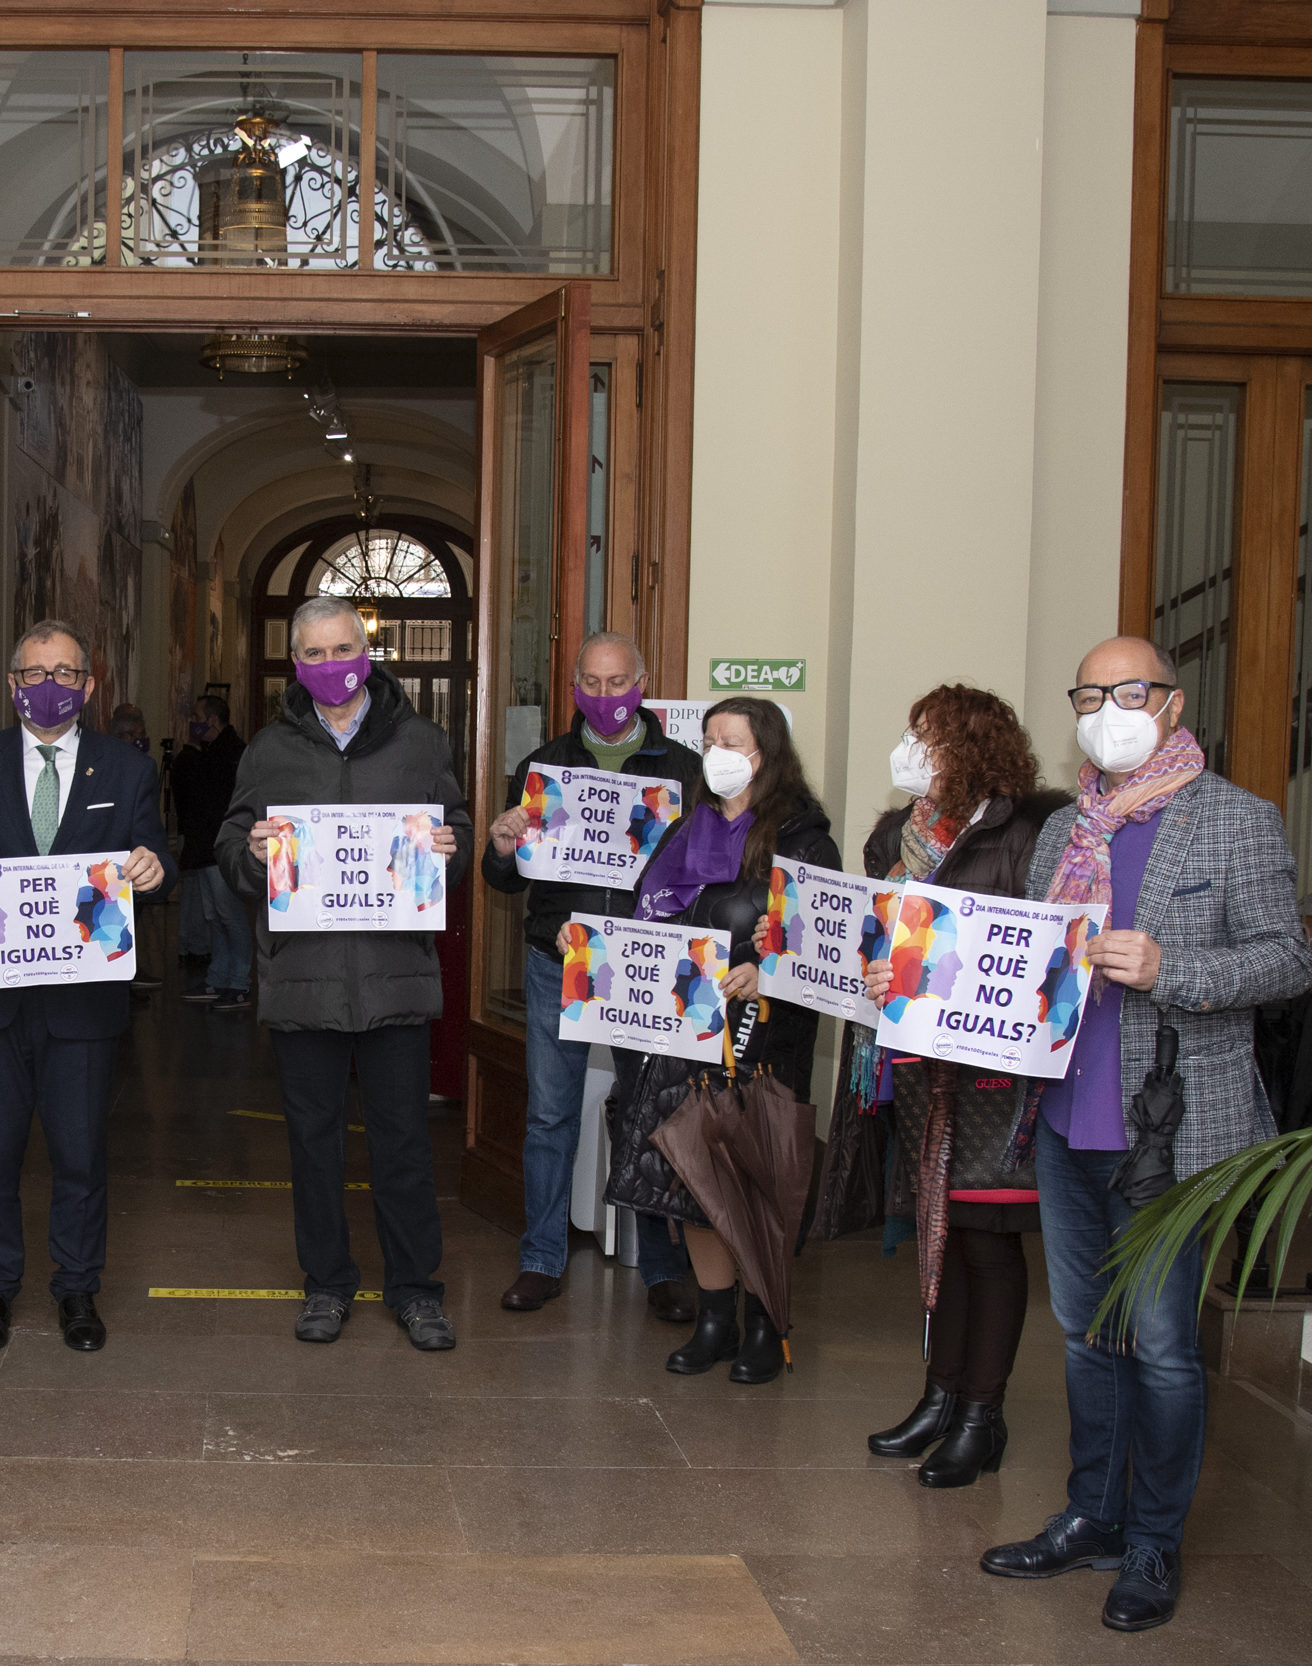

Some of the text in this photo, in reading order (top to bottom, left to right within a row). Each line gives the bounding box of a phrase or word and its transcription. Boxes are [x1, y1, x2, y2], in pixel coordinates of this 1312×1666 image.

[730, 665, 774, 683] DEA
[578, 787, 620, 805] ¿POR
[580, 807, 616, 824] QUÉ
[583, 828, 610, 843] NO
[19, 877, 57, 893] PER
[341, 870, 369, 885] NO
[19, 898, 60, 919] QUÈ
[321, 893, 395, 908] GUALS?
[811, 891, 853, 914] ¿POR
[987, 906, 1031, 919] INTERNACIONAL
[26, 923, 56, 939] NO
[814, 917, 847, 939] QUÉ
[986, 923, 1033, 948] PER
[0, 945, 84, 964] IGUALS?
[621, 940, 666, 960] ¿POR
[818, 943, 841, 964] NO
[625, 964, 660, 983] QUÉ
[977, 953, 1028, 978] QUÈ
[791, 961, 867, 997] IGUALES?
[628, 987, 654, 1005] NO
[975, 984, 1013, 1007] NO
[599, 1006, 683, 1033] IGUALES?
[936, 1008, 1037, 1044] IGUALS?
[975, 1078, 1012, 1089] GUESS
